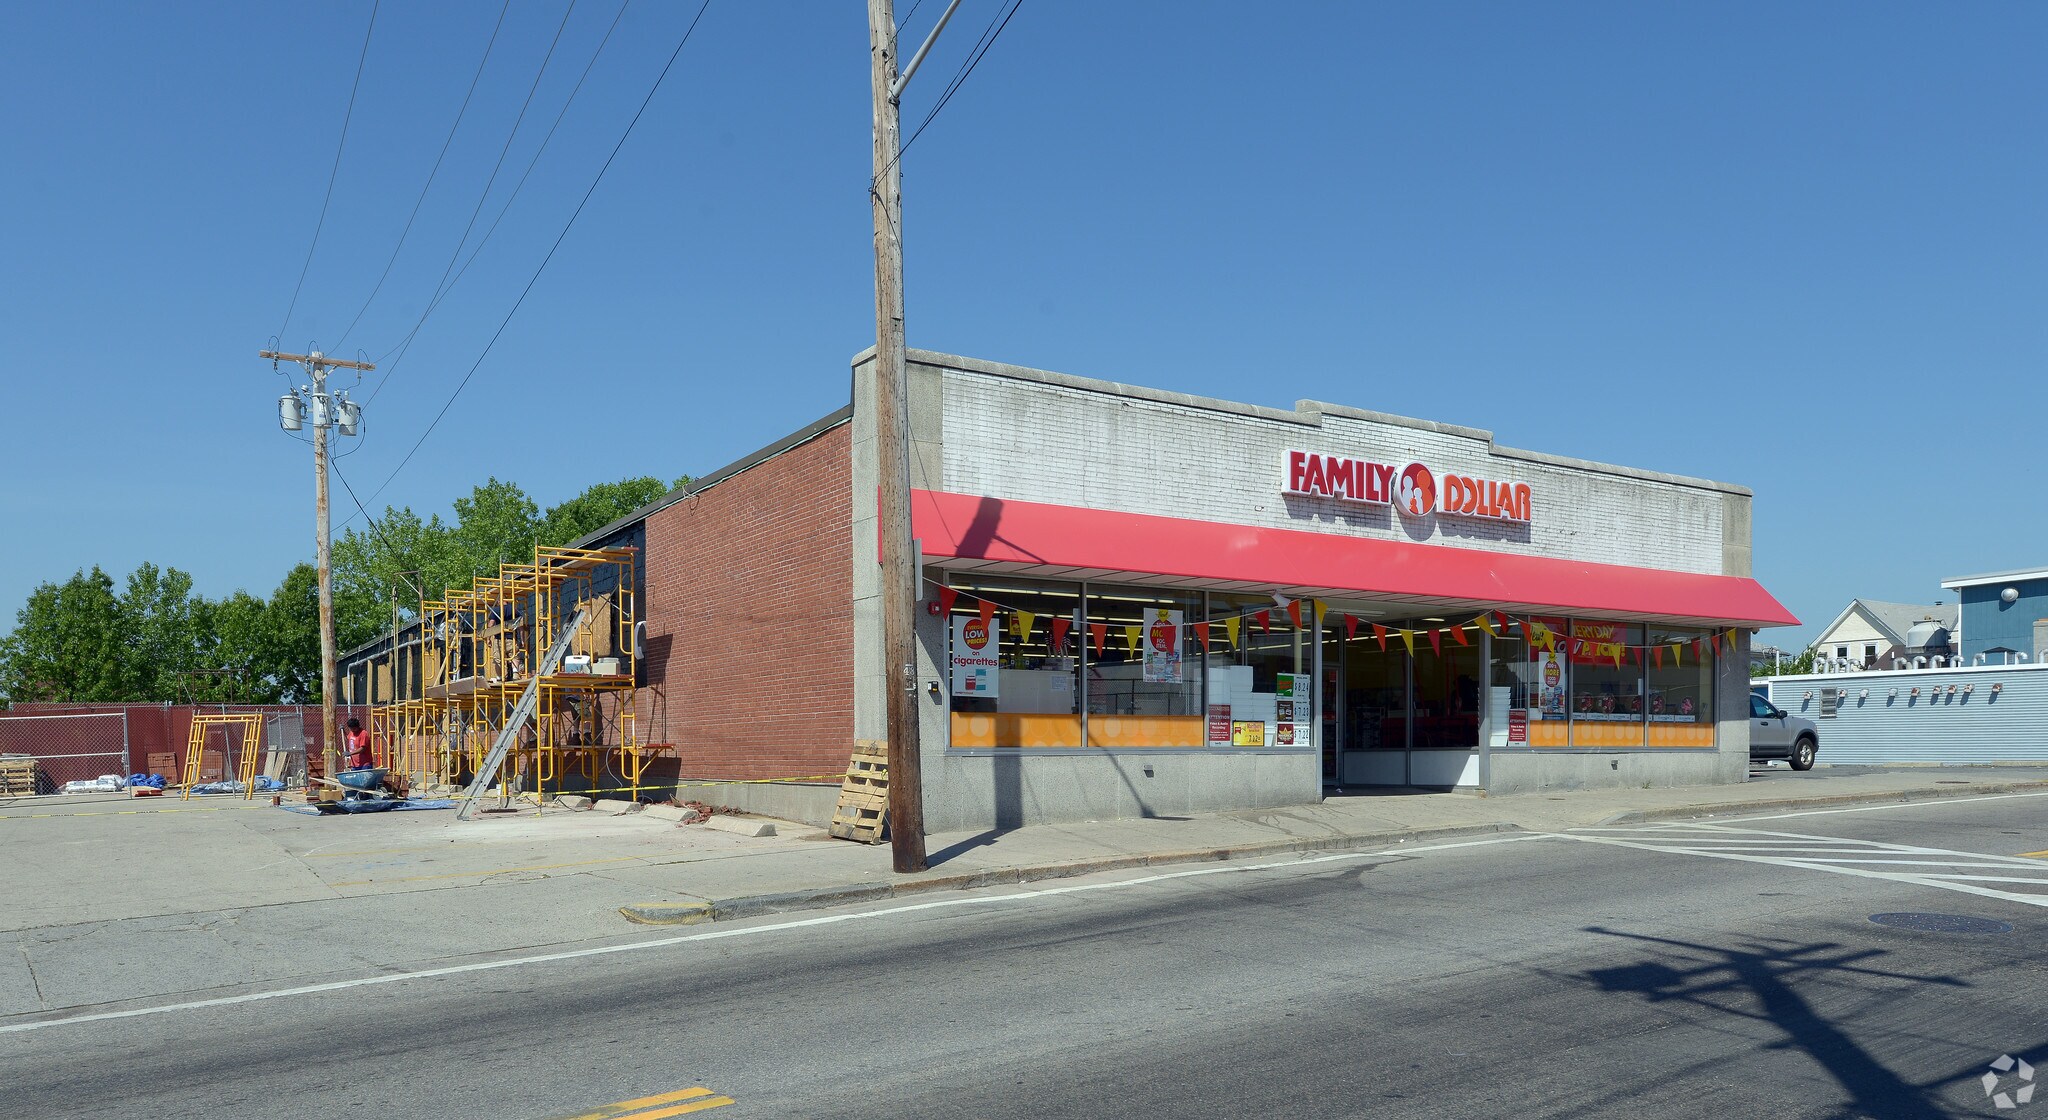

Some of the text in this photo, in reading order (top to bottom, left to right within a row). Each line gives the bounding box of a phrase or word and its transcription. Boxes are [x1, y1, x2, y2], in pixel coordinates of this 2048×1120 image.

[1289, 450, 1532, 521] FAMILY DOLLAR
[954, 655, 997, 666] cigarettes
